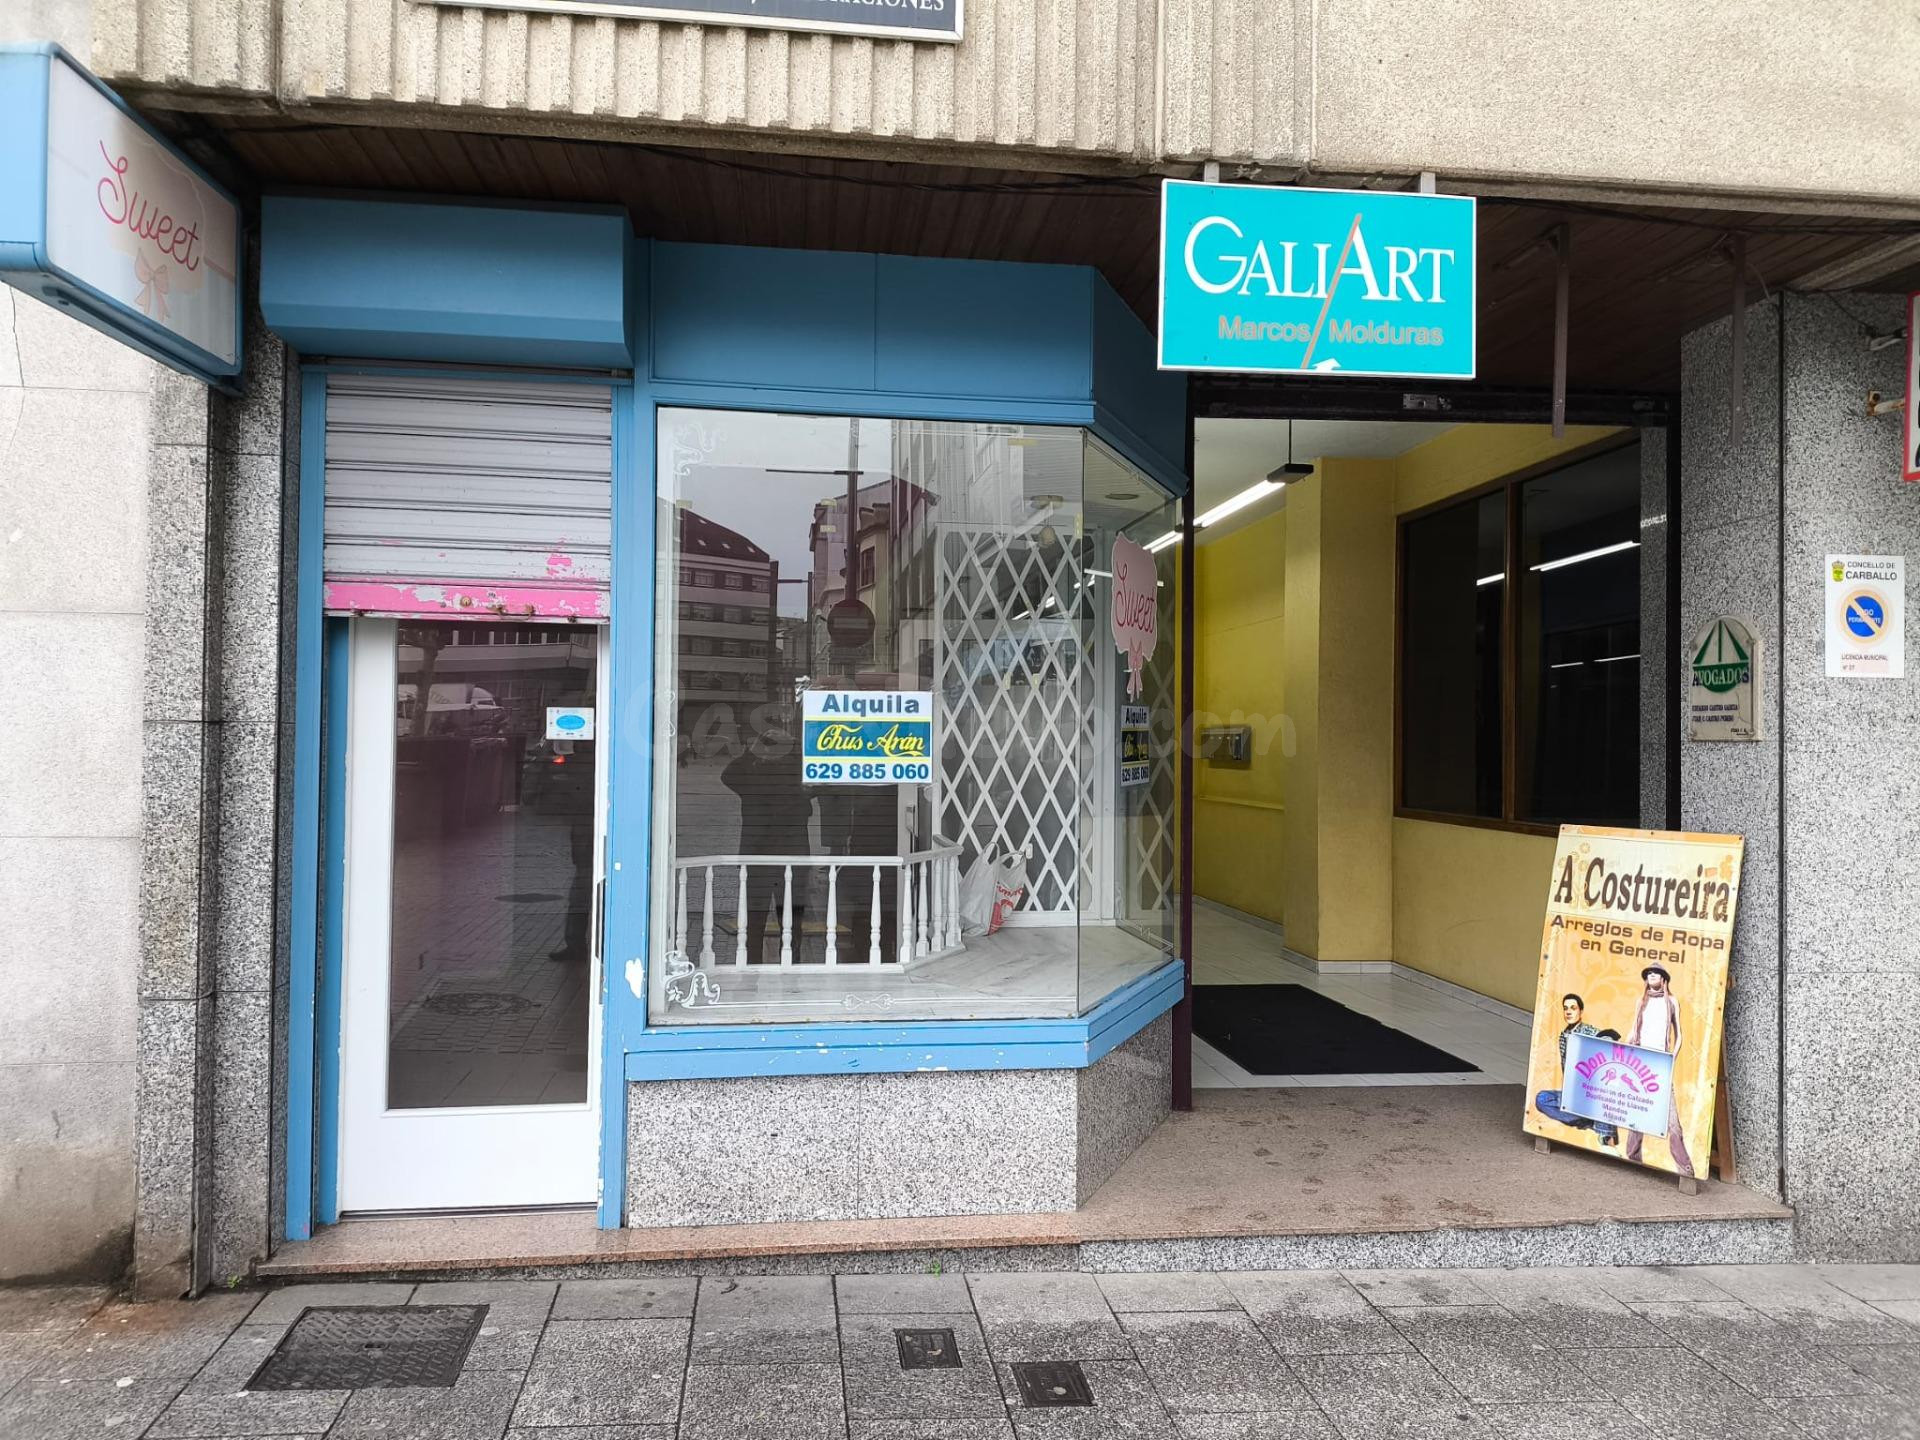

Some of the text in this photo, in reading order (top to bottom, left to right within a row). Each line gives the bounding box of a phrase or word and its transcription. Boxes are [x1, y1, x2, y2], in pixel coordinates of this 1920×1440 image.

[97, 139, 200, 271] Sweet
[1218, 314, 1444, 346] Marcos Molduras
[1845, 570, 1898, 581] CARBALLO
[1847, 561, 1884, 569] CONCELLO
[1115, 561, 1155, 634] Sweet
[1692, 666, 1750, 687] AVOGADOS
[822, 693, 920, 717] Alquila
[816, 723, 864, 752] Chus
[805, 763, 929, 780] 629 885 060
[1553, 854, 1730, 923] A Costureira
[1550, 914, 1725, 951] Arreglos de Ropa
[1580, 939, 1686, 964] en General
[1574, 1043, 1660, 1093] Don Minuto
